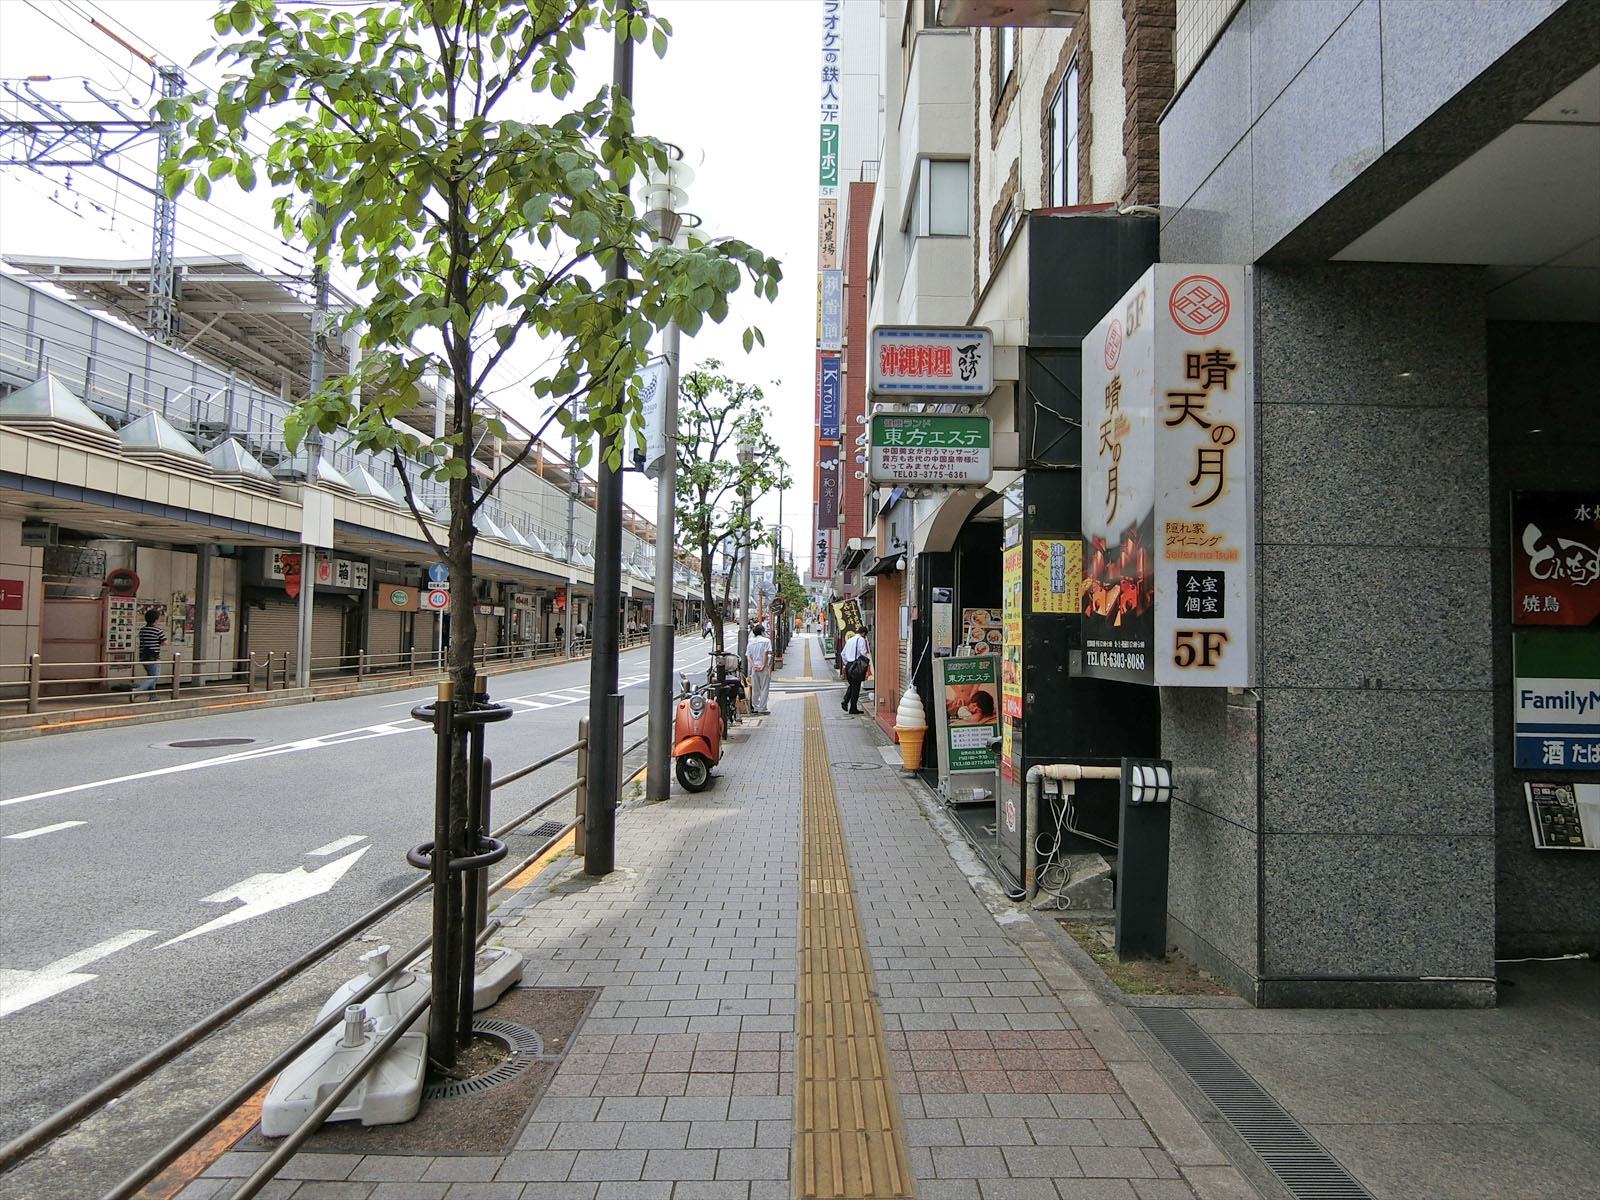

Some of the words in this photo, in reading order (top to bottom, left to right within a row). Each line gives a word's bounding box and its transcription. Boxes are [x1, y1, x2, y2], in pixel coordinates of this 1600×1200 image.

[821, 110, 838, 122] 7F
[822, 187, 835, 196] 5F
[823, 207, 836, 256] 山内農場
[1125, 290, 1146, 337] 5F
[880, 344, 953, 377] 沖縄料理
[823, 368, 838, 418] KIYOMI
[823, 428, 837, 436] 2F
[882, 428, 982, 446] 東方エステ
[1165, 349, 1237, 509] 晴天の月
[882, 447, 979, 456] 中国美女が行うマッサージ
[1099, 374, 1122, 526] 晴天の月
[882, 455, 979, 464] 貴方も古代の中国皇帝様に
[1166, 522, 1205, 535] 隠れ家
[1166, 535, 1222, 547] ダイニング
[1215, 550, 1238, 560] Tsuki
[1050, 542, 1065, 593] 沖縄料理
[1185, 575, 1218, 593] 全室
[432, 594, 444, 604] 40
[1184, 596, 1218, 613] 個室
[1522, 594, 1560, 612] 焼鳥
[1174, 630, 1229, 668] 5F
[1087, 651, 1099, 666] TEL
[1100, 651, 1145, 671] 03-6303-8088
[948, 672, 991, 683] 東方エステ
[1542, 740, 1565, 766] 酒
